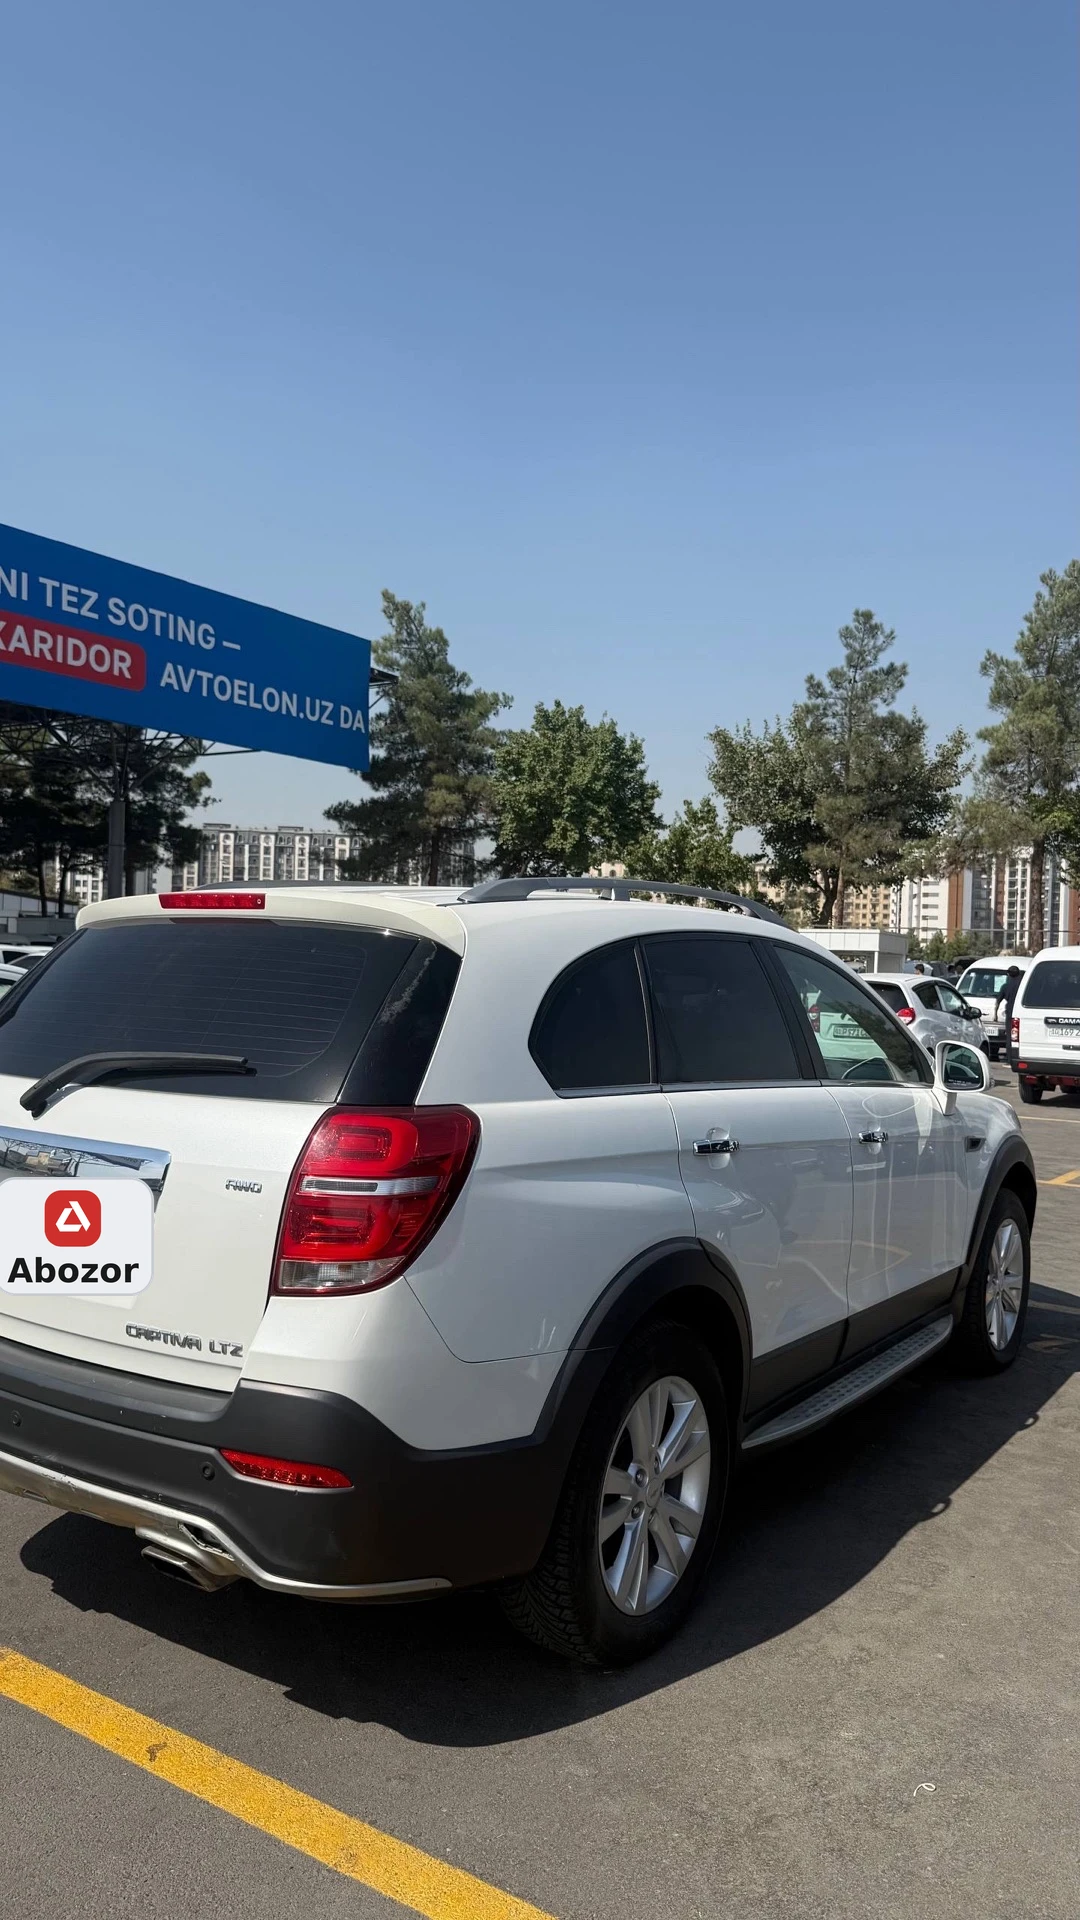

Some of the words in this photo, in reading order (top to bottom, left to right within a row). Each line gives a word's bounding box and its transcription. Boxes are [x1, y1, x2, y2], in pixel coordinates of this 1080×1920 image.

[0, 566, 28, 601] NI
[38, 576, 99, 620] TEZ
[107, 597, 216, 650] SOTING
[0, 620, 132, 679] ARIDOR
[160, 662, 334, 726] AVTOELON.UZ
[339, 707, 366, 734] DA
[1060, 1028, 1074, 1036] 169
[225, 1179, 262, 1193] AWD
[125, 1322, 202, 1351] CAPTIVA
[208, 1339, 243, 1358] LTZ
